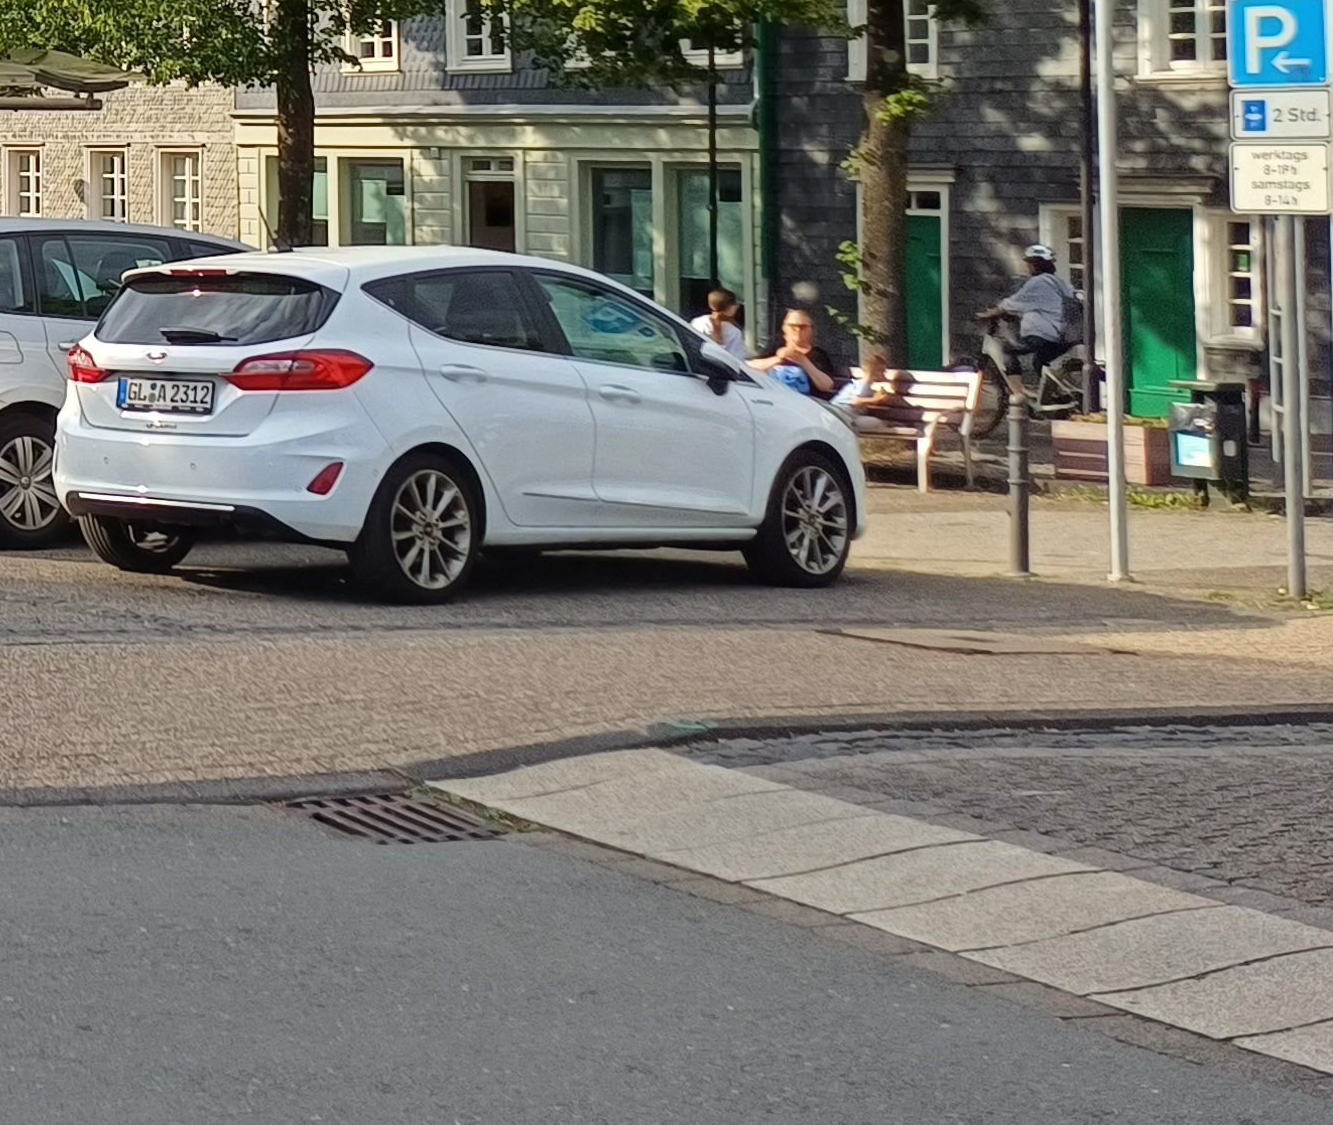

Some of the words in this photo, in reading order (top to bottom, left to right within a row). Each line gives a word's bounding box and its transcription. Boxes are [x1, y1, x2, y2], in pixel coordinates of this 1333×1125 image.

[1243, 5, 1298, 75] P
[1273, 107, 1283, 123] 2
[1287, 107, 1322, 124] Std.
[1251, 150, 1309, 163] werktags
[1251, 180, 1311, 193] samstags
[127, 382, 147, 401] GL
[157, 383, 167, 403] A
[170, 384, 210, 405] 2312
